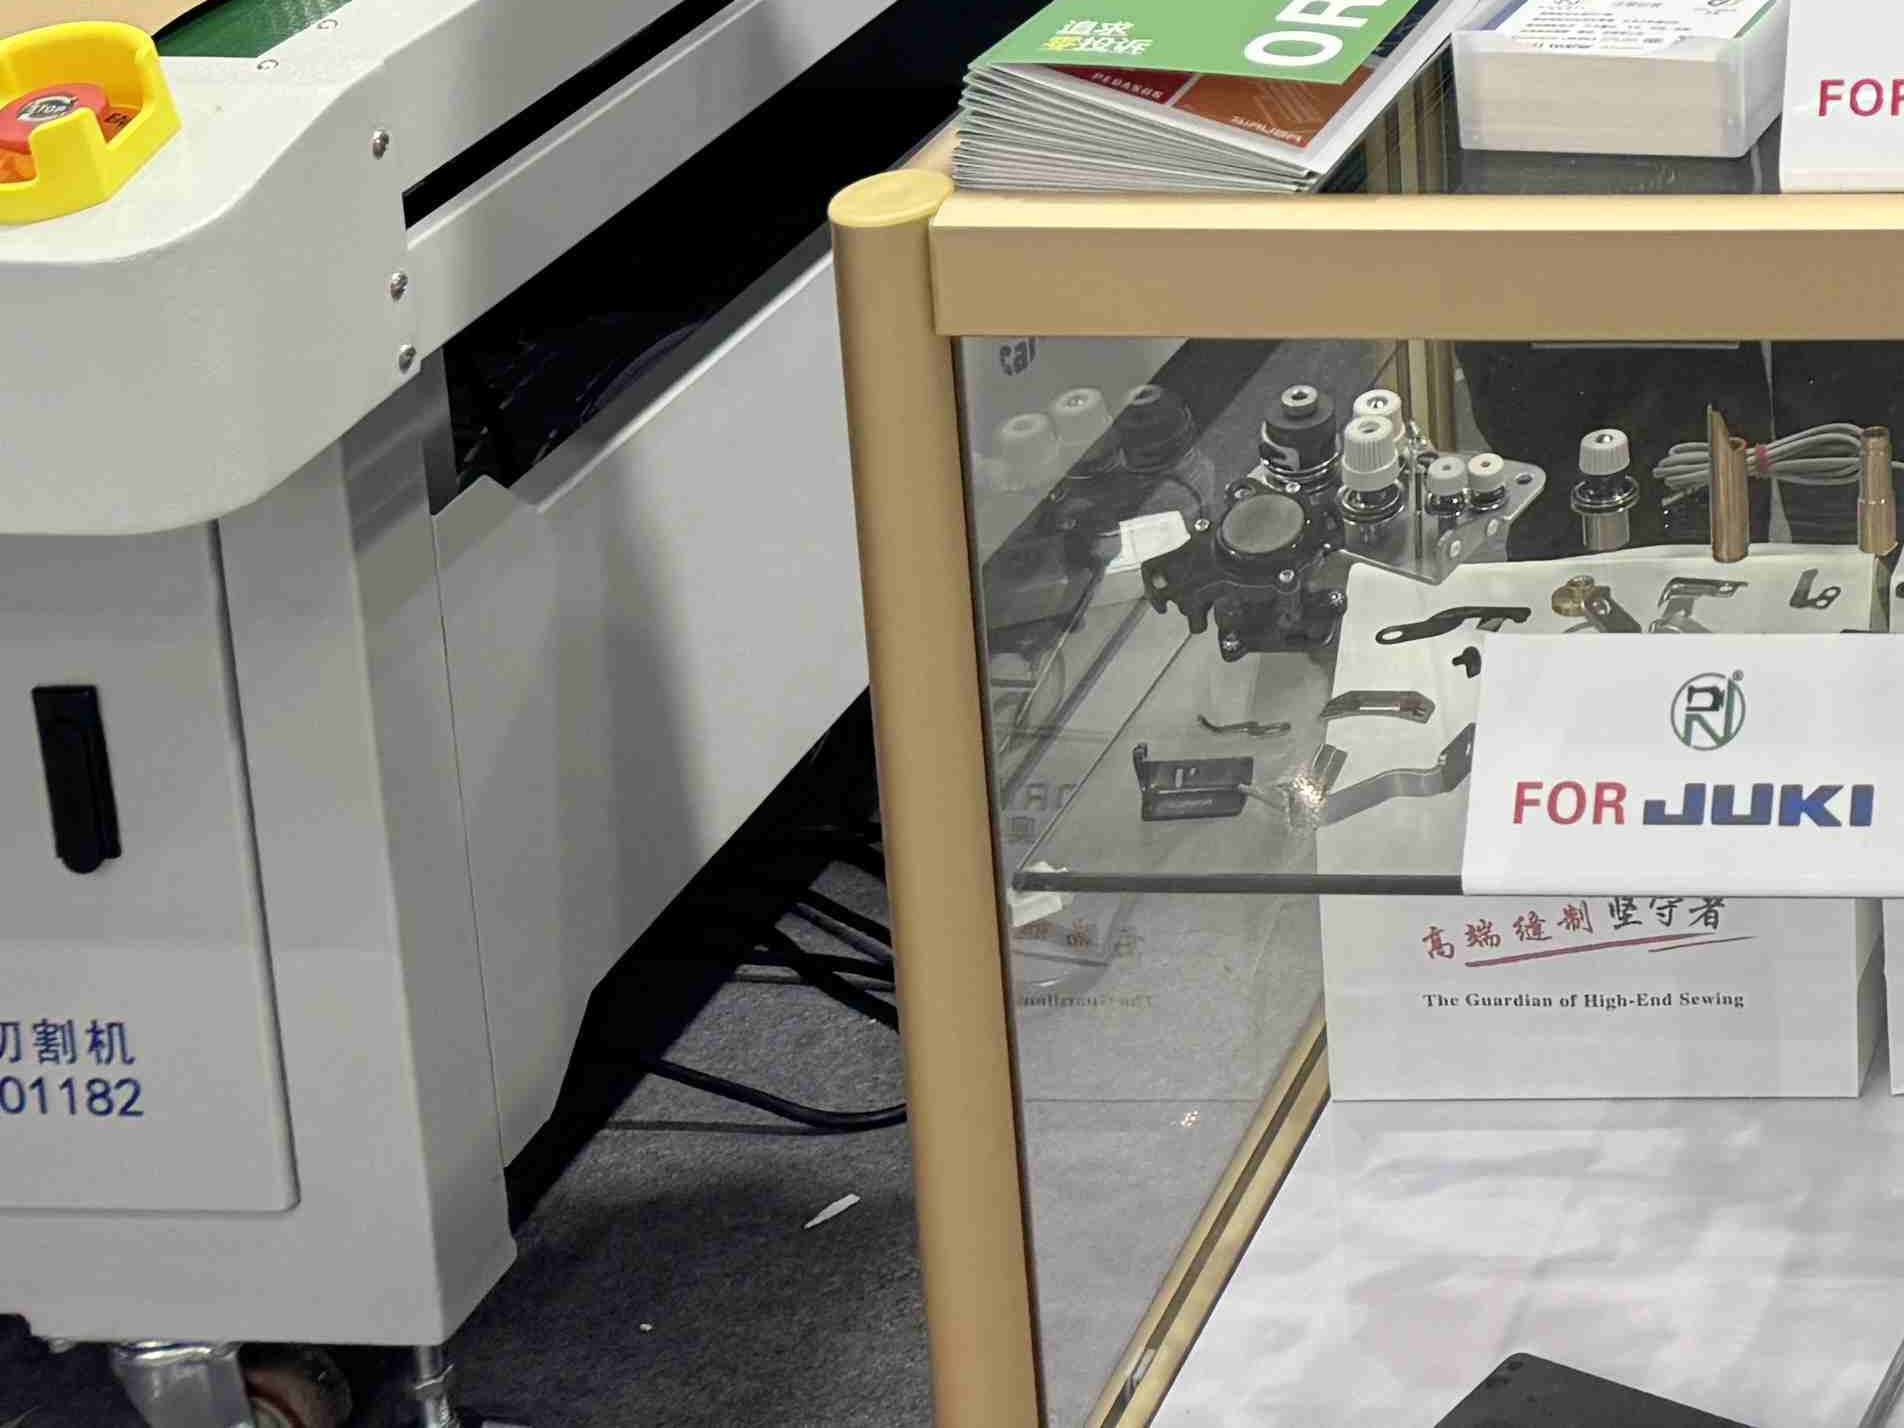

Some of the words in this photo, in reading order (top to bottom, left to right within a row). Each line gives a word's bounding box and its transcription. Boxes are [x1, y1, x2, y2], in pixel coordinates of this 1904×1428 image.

[1512, 780, 1627, 827] FOR
[1642, 783, 1875, 828] JUKI
[1422, 897, 1727, 959] 高端缝制坚守者
[1422, 993, 1459, 1008] The
[1465, 993, 1552, 1008] Guardian
[1560, 993, 1578, 1008] of
[1584, 993, 1673, 1011] High-End
[1679, 992, 1745, 1009] Sewing
[0, 1076, 144, 1117] 01182
